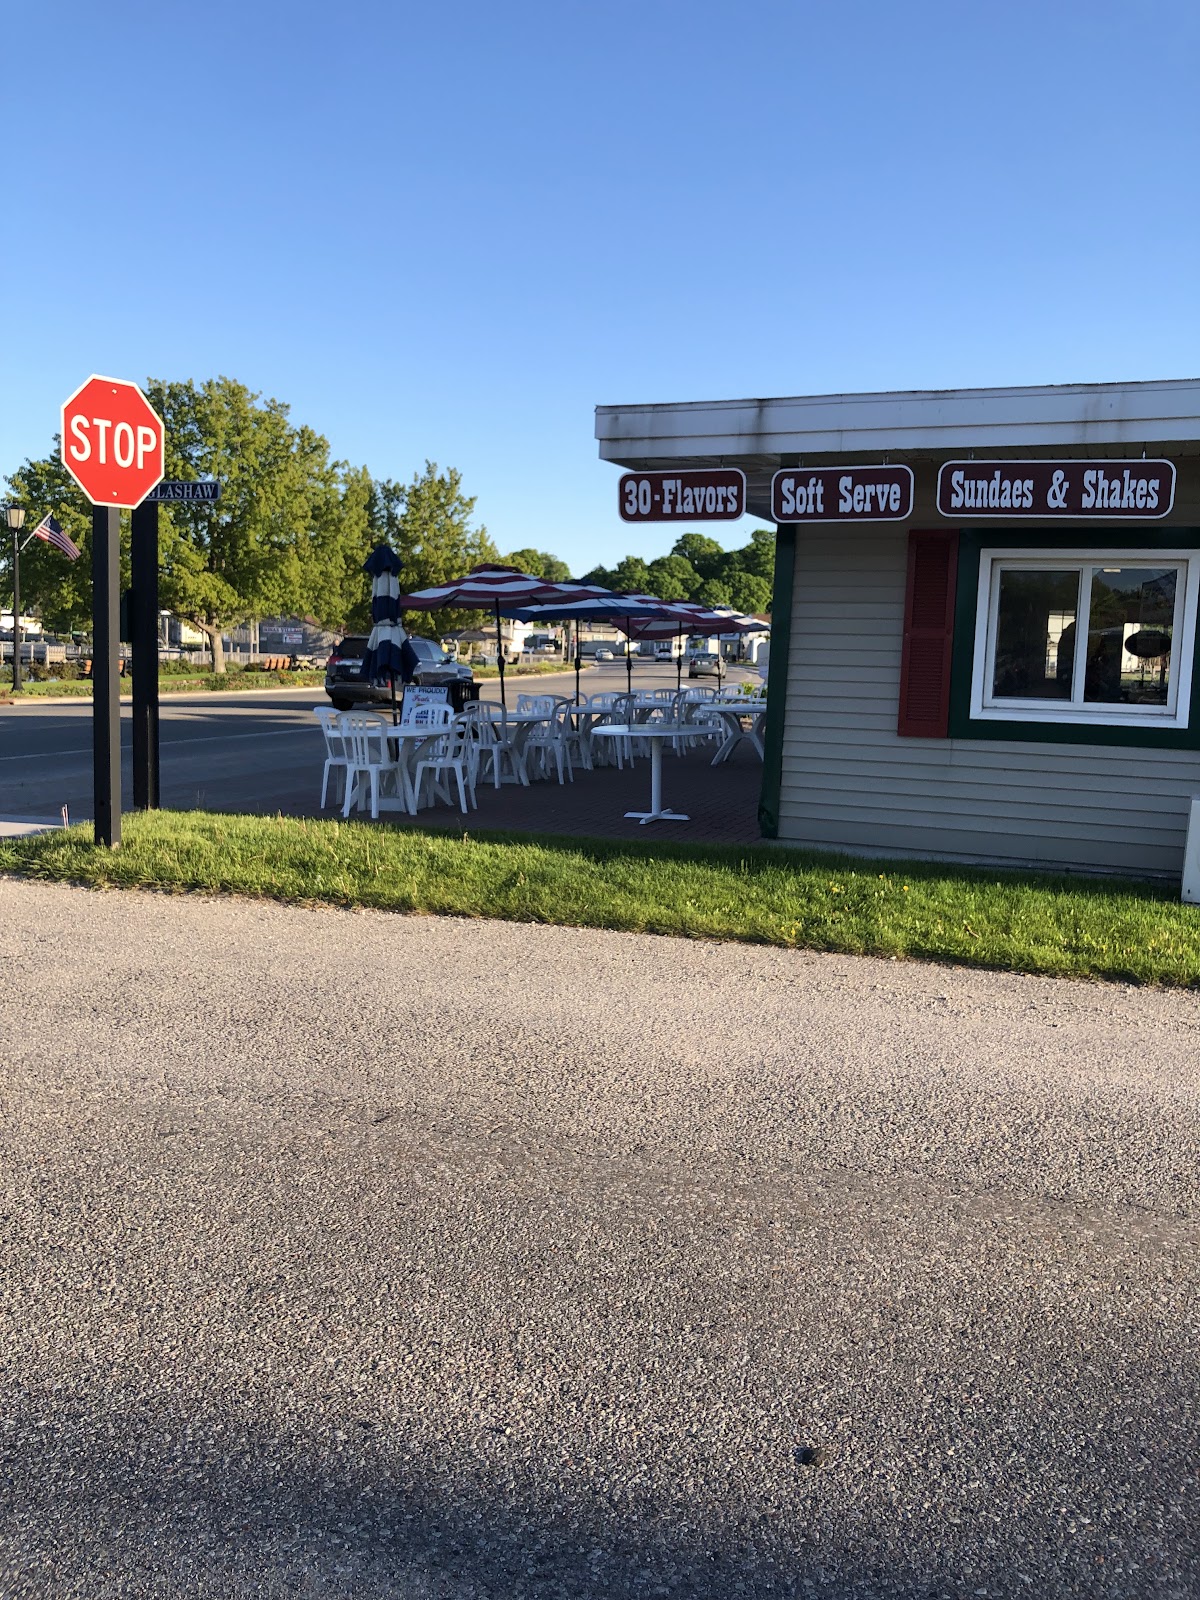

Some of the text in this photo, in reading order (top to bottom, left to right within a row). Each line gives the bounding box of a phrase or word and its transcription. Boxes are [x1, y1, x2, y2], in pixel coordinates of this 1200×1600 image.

[70, 414, 157, 470] STOP
[781, 475, 901, 514] Soft Serve
[951, 469, 1160, 509] Sundaes & Shakes
